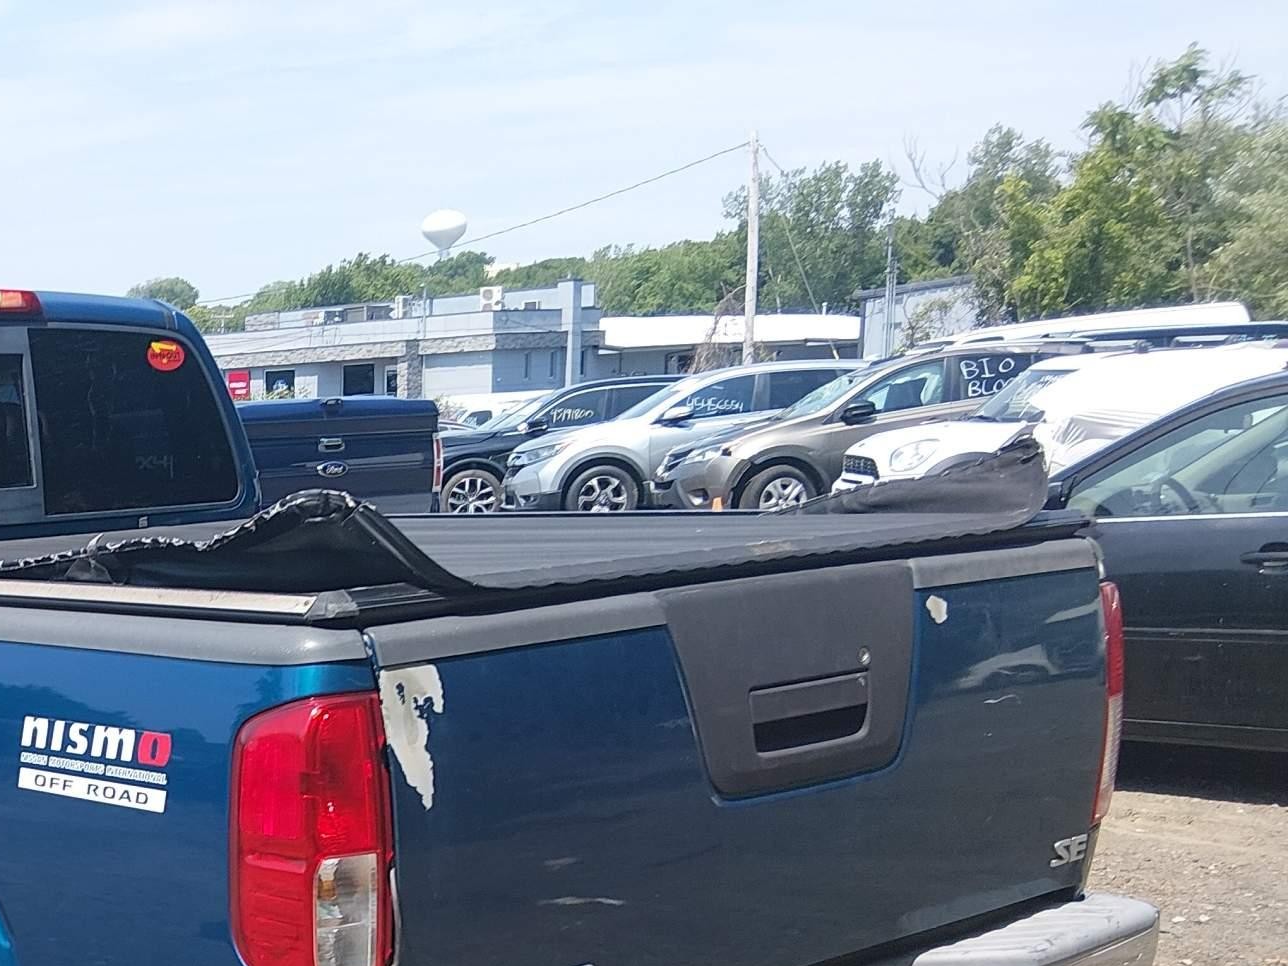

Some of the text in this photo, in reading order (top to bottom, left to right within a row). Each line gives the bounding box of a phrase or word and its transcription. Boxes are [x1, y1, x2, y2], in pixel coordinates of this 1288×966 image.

[34, 774, 149, 805] OFF ROAD
[1050, 834, 1088, 867] SE
